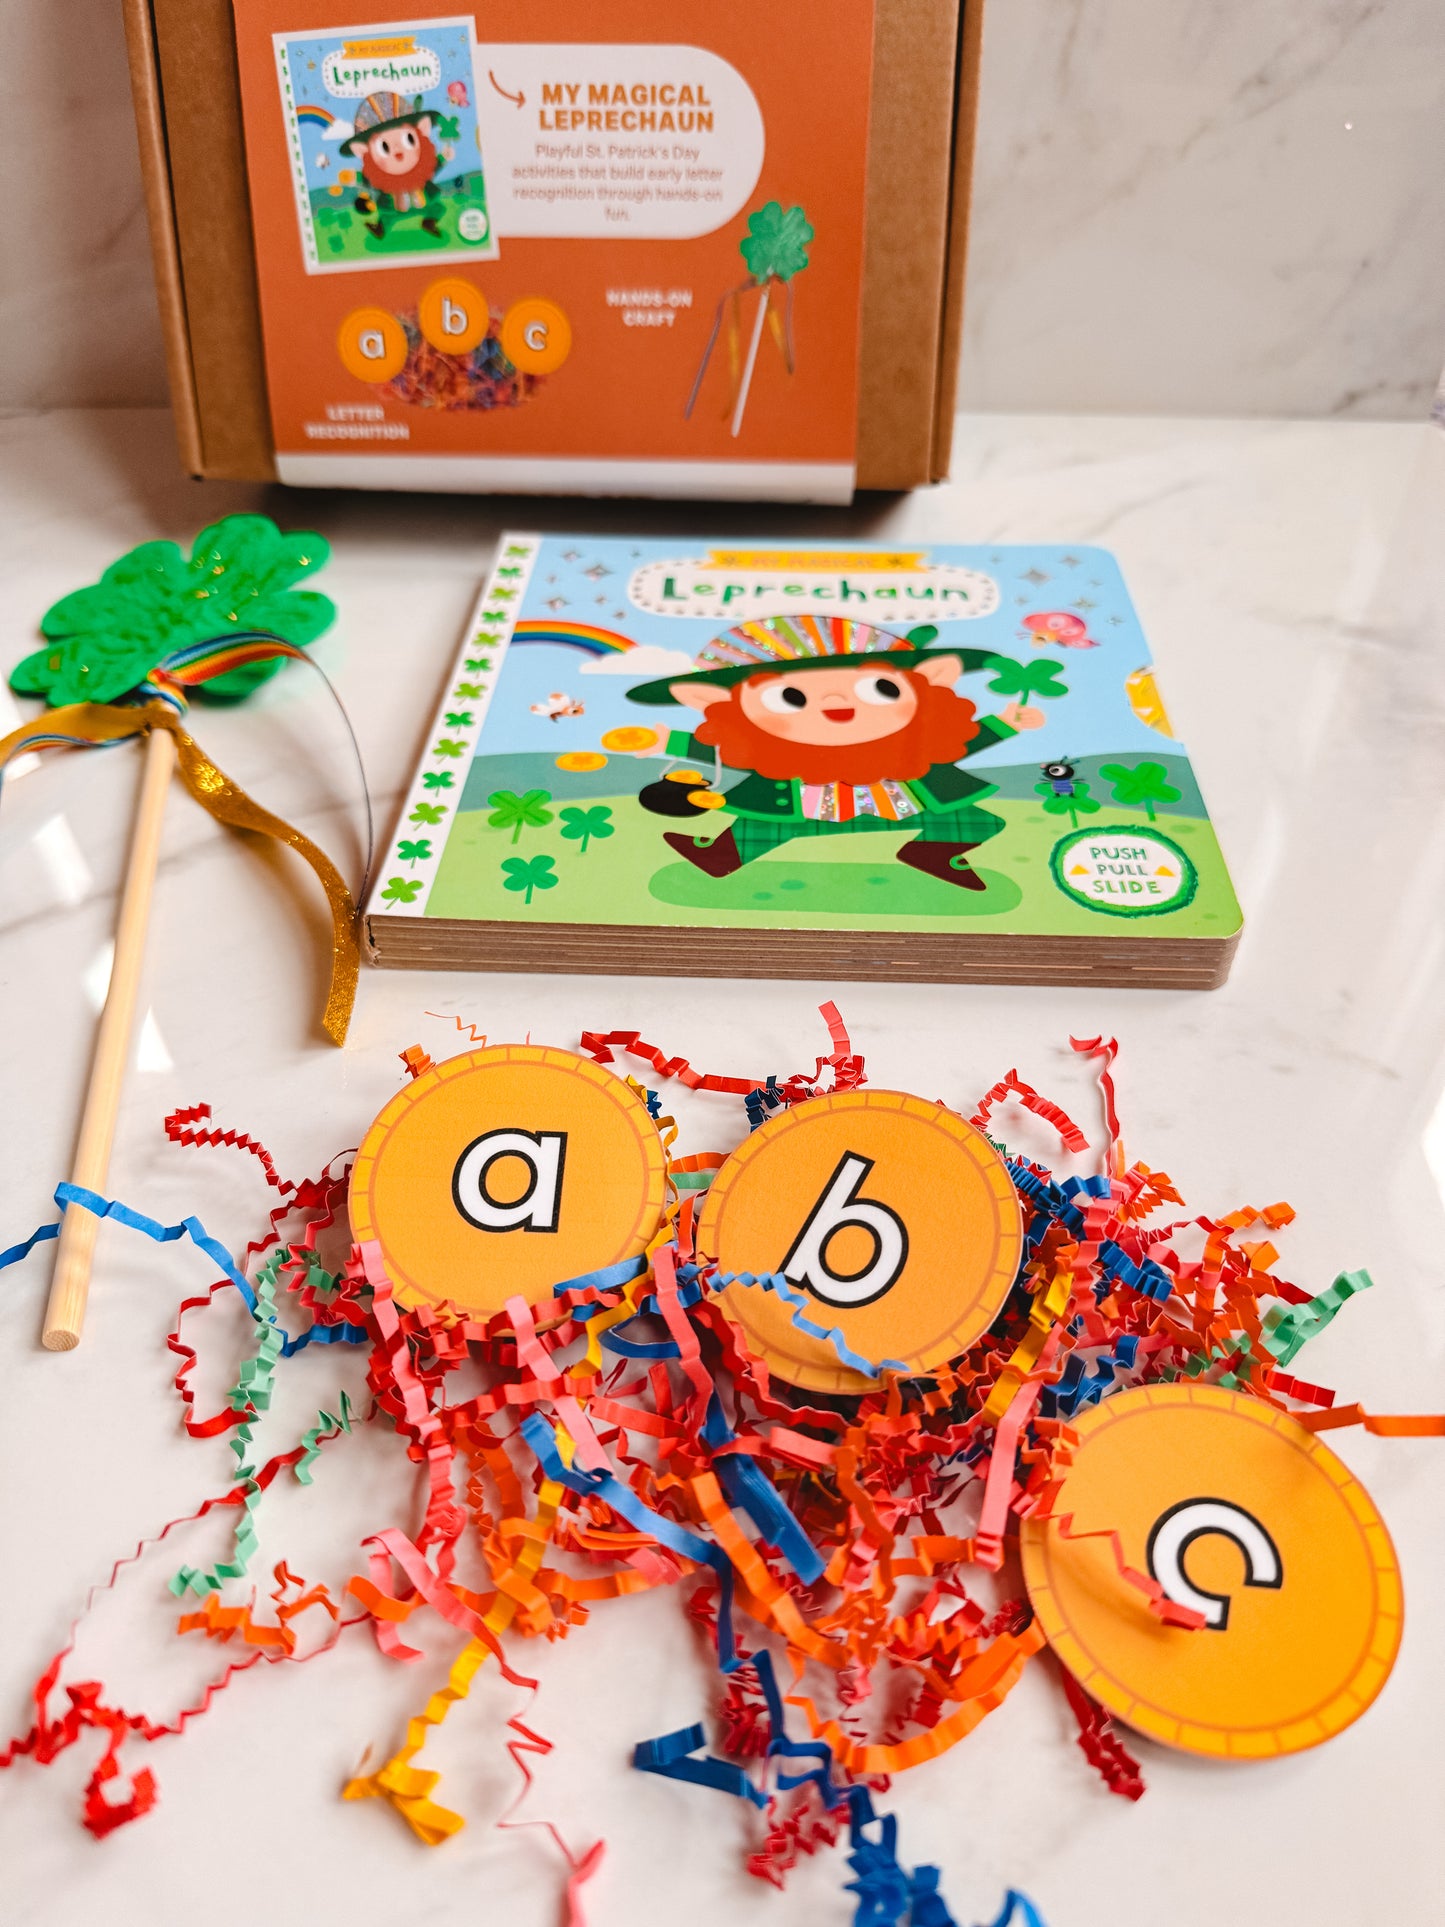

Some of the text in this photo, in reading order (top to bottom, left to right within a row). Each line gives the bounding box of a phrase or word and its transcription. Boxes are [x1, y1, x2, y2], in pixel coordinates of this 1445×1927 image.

[333, 61, 432, 88] Leprechaun
[542, 84, 711, 106] MY MAGICAL
[539, 109, 714, 132] LEPRECHAUN
[535, 145, 583, 160] Playful
[608, 145, 669, 159] Patrick's
[671, 145, 700, 161] Day
[512, 166, 723, 183] activities that build early letter
[512, 187, 723, 203] recognition through hands-on
[442, 297, 468, 335] b
[359, 329, 386, 359] a
[524, 321, 549, 351] c
[663, 576, 969, 605] Leprechaun
[1089, 846, 1148, 861] PUSH
[1096, 863, 1149, 876] PULL
[1092, 879, 1162, 894] SLIDE
[451, 1127, 568, 1233] a
[776, 1149, 909, 1309] b
[1146, 1496, 1283, 1631] c
